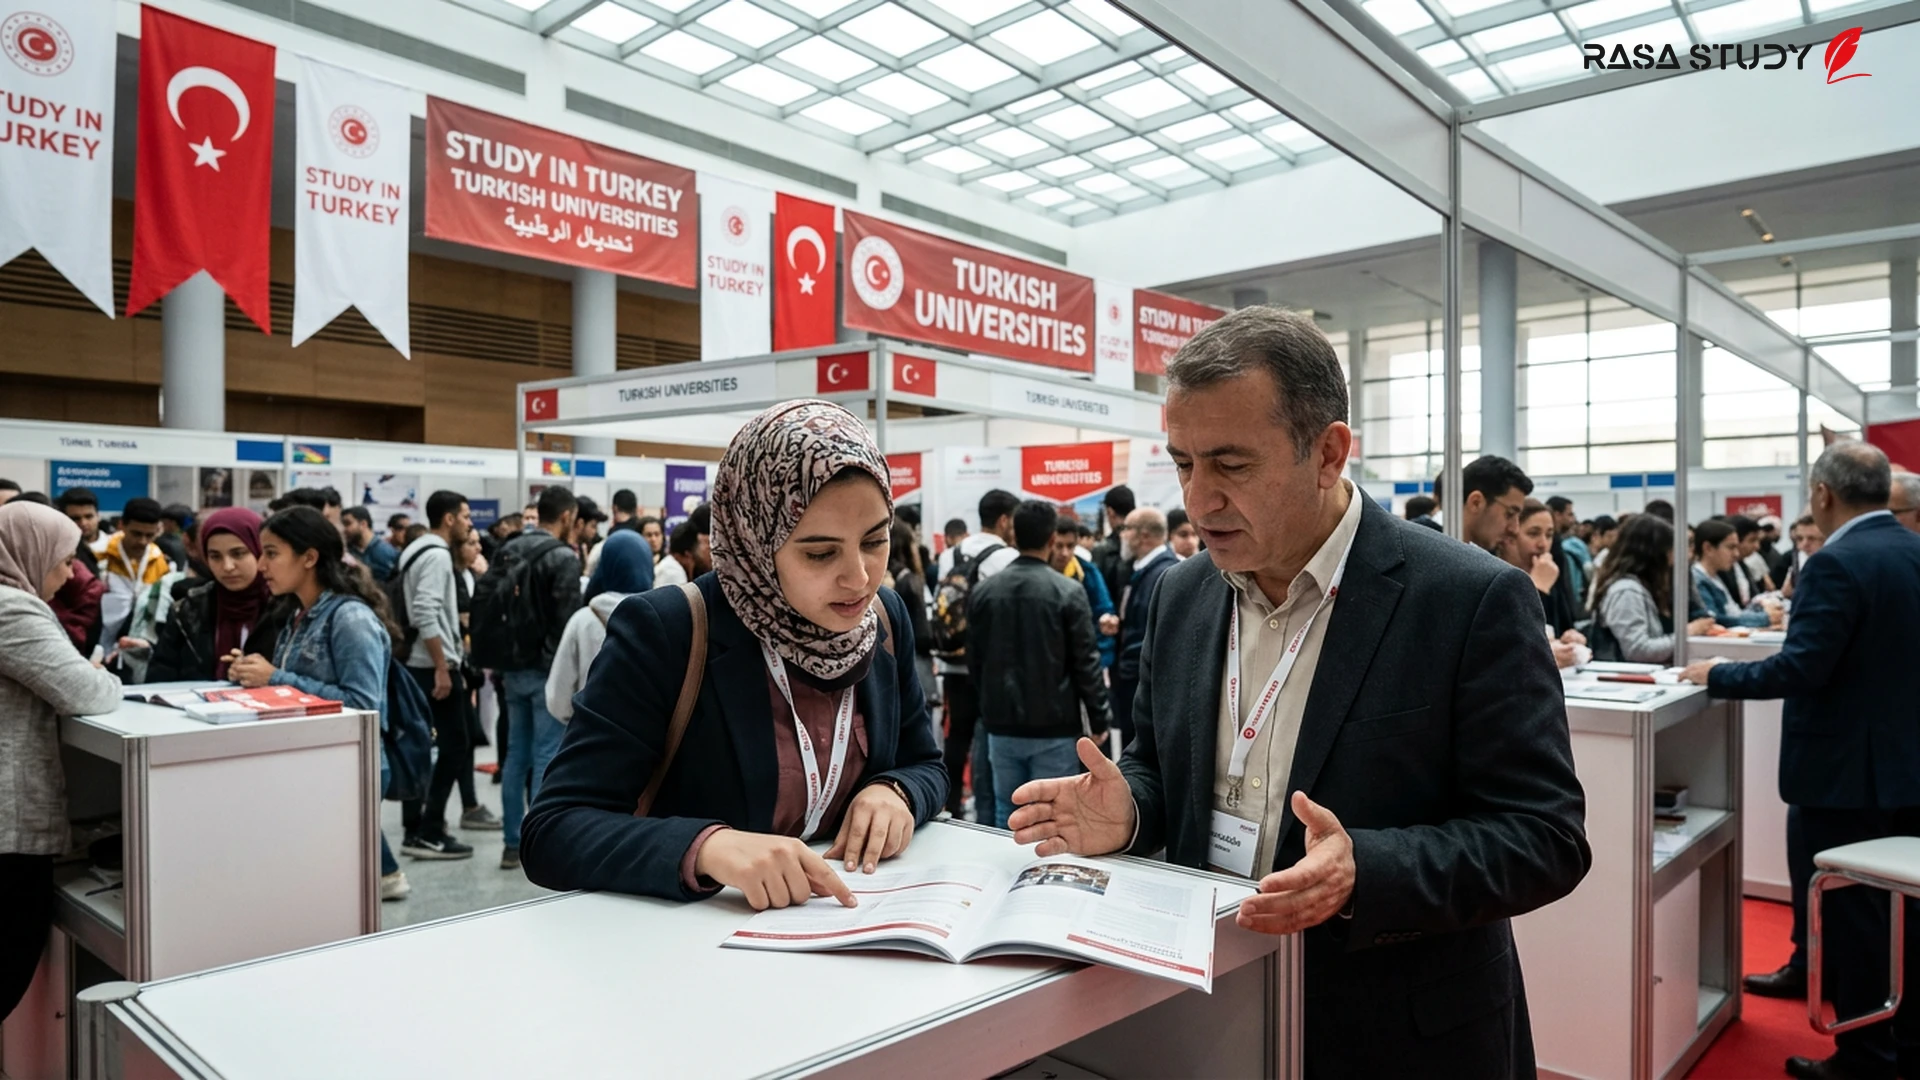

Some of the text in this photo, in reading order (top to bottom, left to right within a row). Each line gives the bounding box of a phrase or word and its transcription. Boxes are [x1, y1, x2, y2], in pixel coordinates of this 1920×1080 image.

[75, 107, 102, 132] IN
[306, 166, 400, 201] STUDY IN
[445, 130, 683, 213] STUDY IN TURKEY
[305, 189, 400, 226] TURKEY
[450, 166, 679, 239] TURKISH UNIVERSITIES
[707, 272, 764, 297] TURKEY
[952, 256, 1058, 313] TURKISH
[914, 288, 1086, 358] UNIVERSITIES
